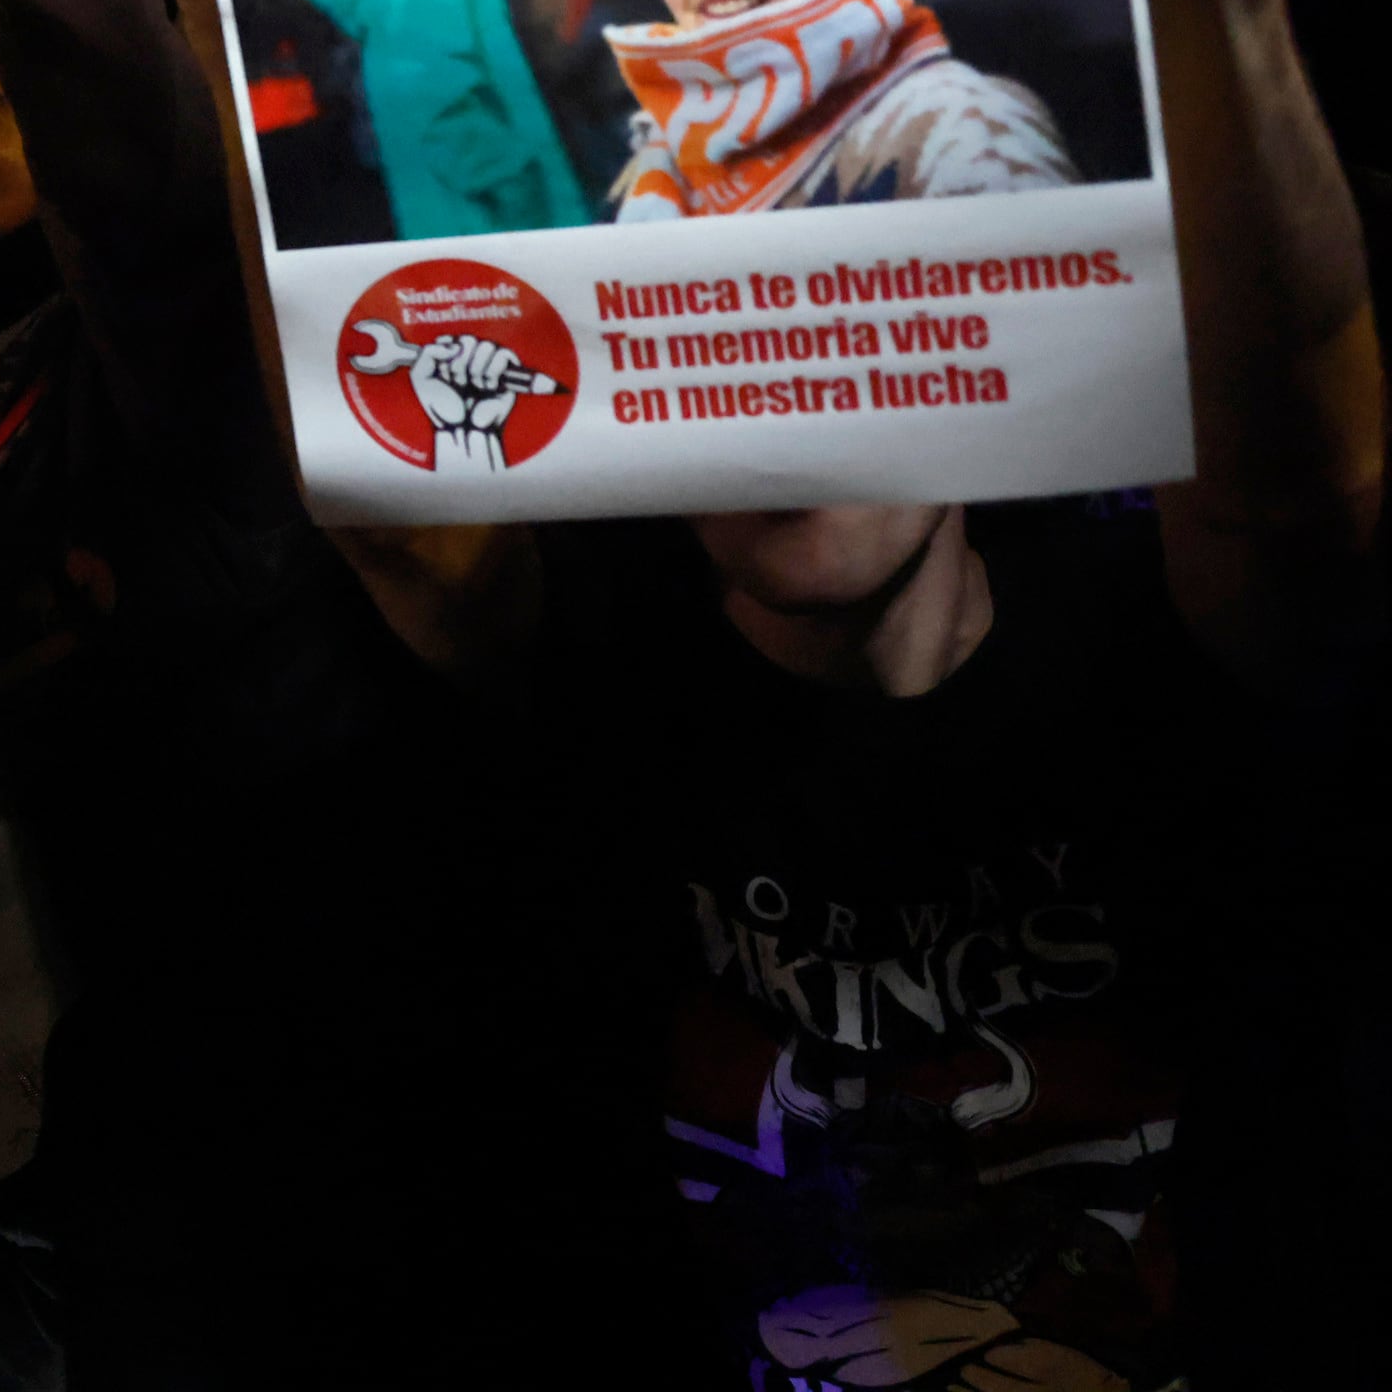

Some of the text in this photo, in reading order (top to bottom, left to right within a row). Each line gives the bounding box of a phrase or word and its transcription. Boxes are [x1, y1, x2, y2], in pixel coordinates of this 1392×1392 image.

[395, 281, 520, 305] Sindicato de
[401, 304, 523, 326] Estudiantes
[595, 248, 1135, 321] Nunca te olvidaremos.
[601, 308, 992, 372] Tu memoria vive
[611, 362, 1009, 425] en nuestra lucha
[745, 841, 1071, 952] ORWAY
